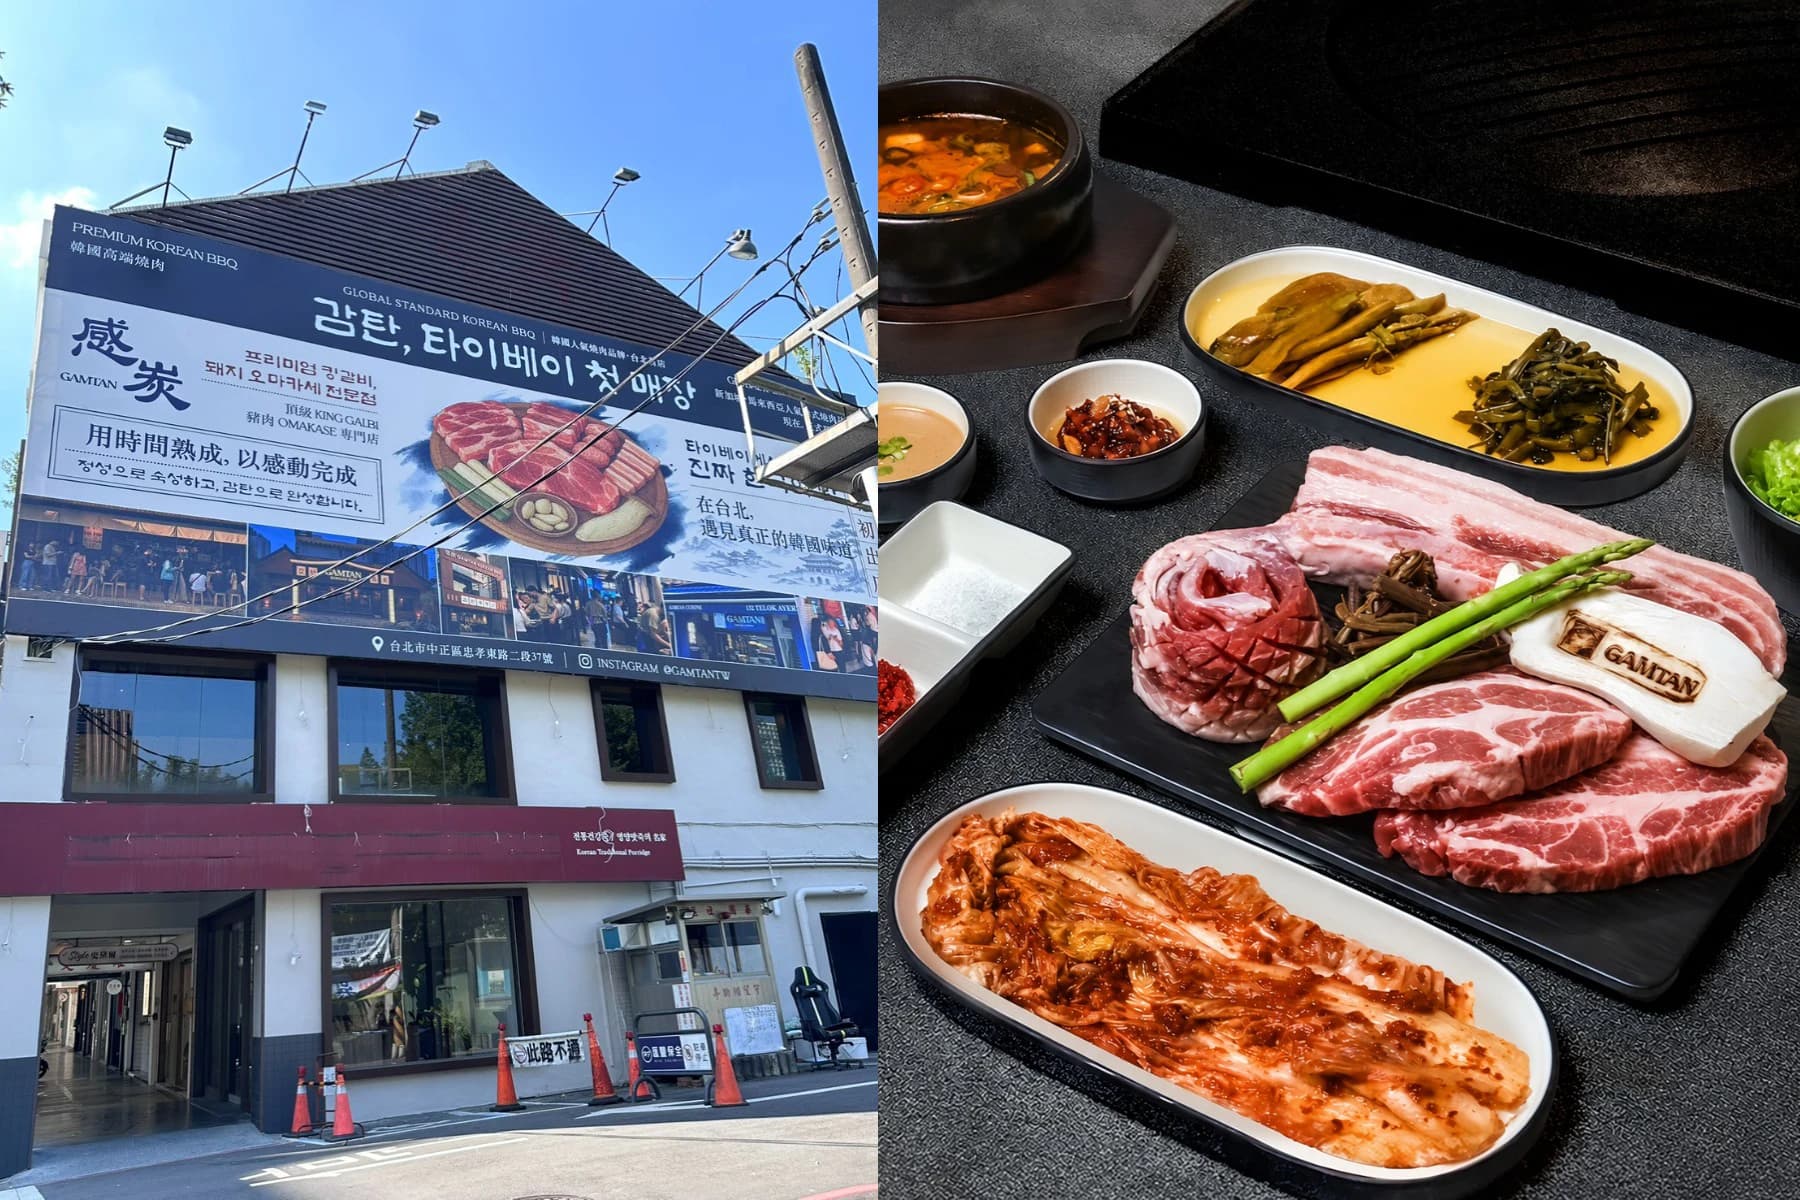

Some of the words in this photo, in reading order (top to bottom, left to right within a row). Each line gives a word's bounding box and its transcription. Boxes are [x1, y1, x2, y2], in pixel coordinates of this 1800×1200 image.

[70, 240, 165, 272] 韓國高端燒肉
[72, 222, 143, 248] PREMIUM
[146, 239, 204, 261] KOREAN
[207, 253, 239, 271] BBQ
[343, 286, 392, 306] GLOBAL
[395, 299, 459, 321] STANDARD
[462, 314, 508, 333] KOREAN
[512, 326, 537, 341] BBQ
[245, 350, 317, 376] 프리미엄
[321, 365, 377, 390] 킹갈비,
[313, 296, 412, 356] 감탄,
[421, 323, 575, 387] 타이베이
[585, 359, 620, 395] 첫
[630, 371, 697, 410] 매장
[60, 371, 117, 390] GAMTAN
[205, 360, 243, 379] 돼지
[248, 369, 321, 395] 오마카세
[325, 384, 377, 406] 전문점
[246, 411, 275, 427] 豬肉
[278, 418, 337, 437] OMAKASE
[285, 403, 312, 419] 頂級
[315, 409, 344, 424] KING
[344, 413, 379, 430] GALBI
[78, 459, 146, 481] 정성으로
[150, 470, 219, 492] 숙성하고,
[223, 480, 283, 500] 감탄으로
[287, 489, 363, 513] 완성합니다.
[688, 457, 735, 484] 진짜
[700, 518, 857, 559] 遇見真正的韓國味道
[597, 657, 659, 674] INSTAGRAM
[663, 664, 731, 681] @GAMTANTW
[1604, 643, 1700, 696] GAMTAN
[628, 849, 651, 857] Porridge
[527, 1038, 581, 1063] 此路不通
